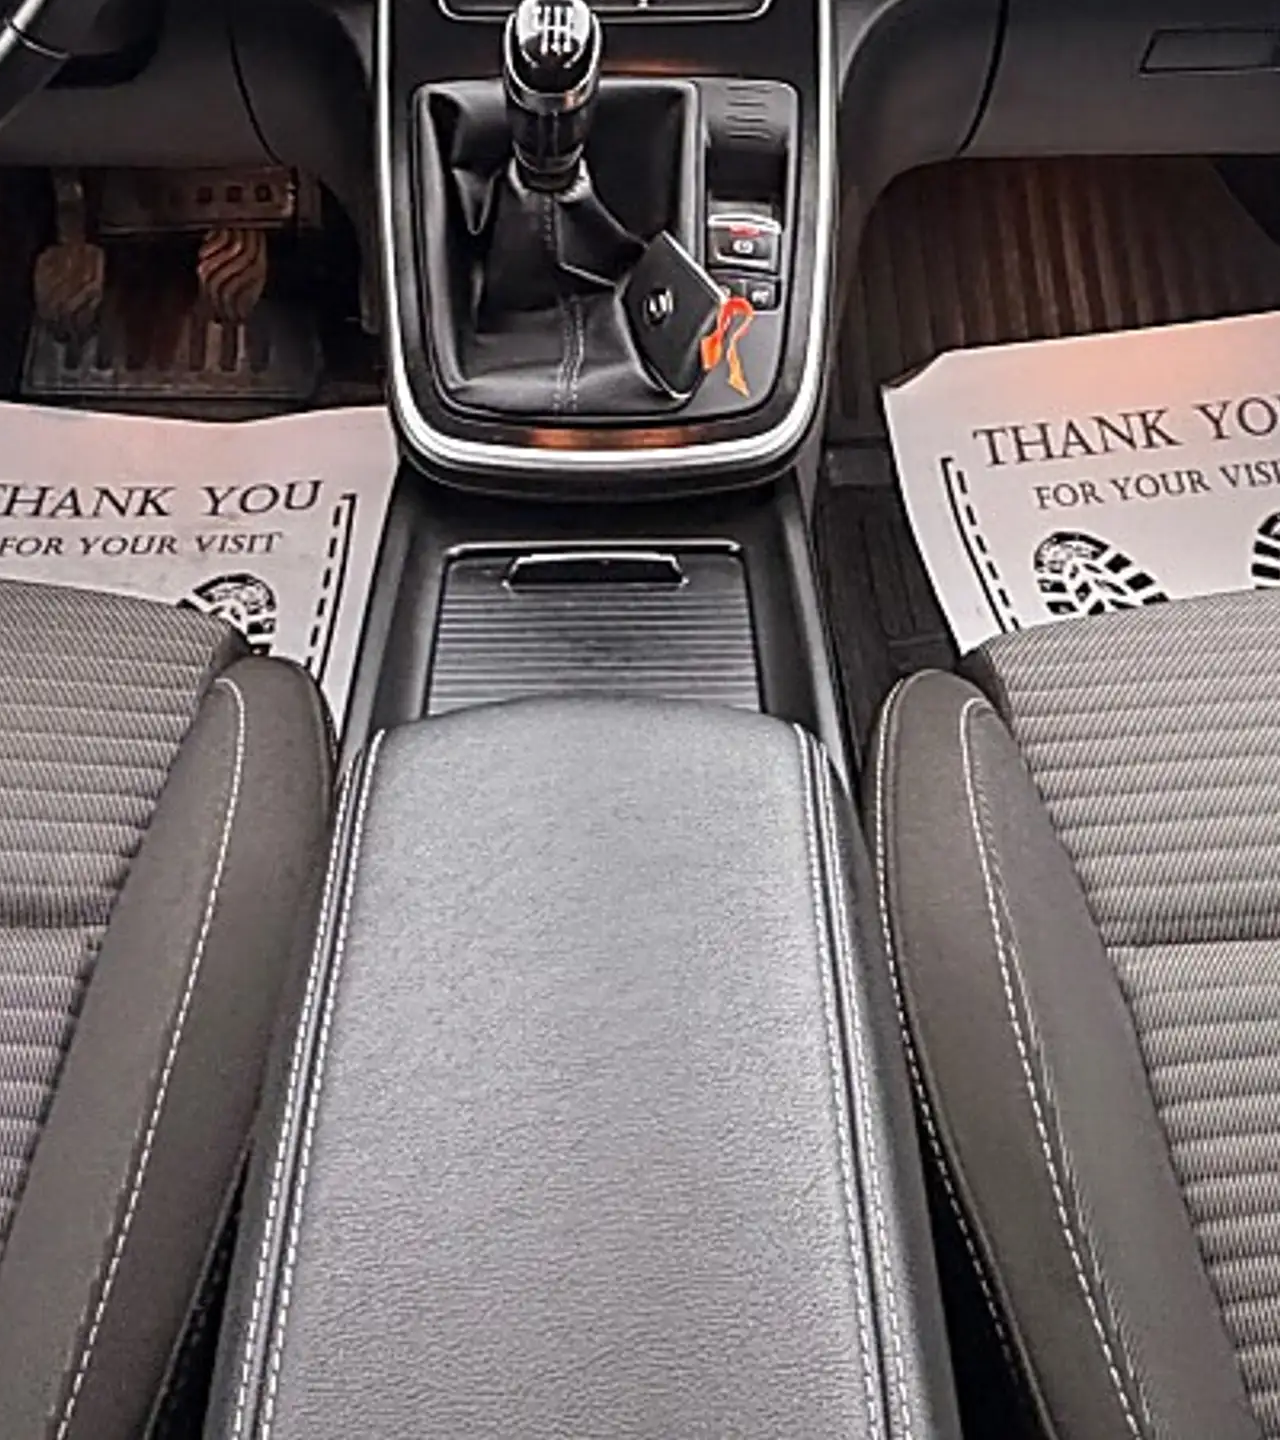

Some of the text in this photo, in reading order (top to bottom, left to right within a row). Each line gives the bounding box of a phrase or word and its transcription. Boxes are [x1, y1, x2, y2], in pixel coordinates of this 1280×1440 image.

[972, 408, 1184, 467] THANK
[199, 479, 324, 517] YOU
[1032, 479, 1105, 511] FOR
[1108, 468, 1213, 502] YOUR
[78, 533, 179, 557] YOUR
[194, 530, 284, 554] VISIT
